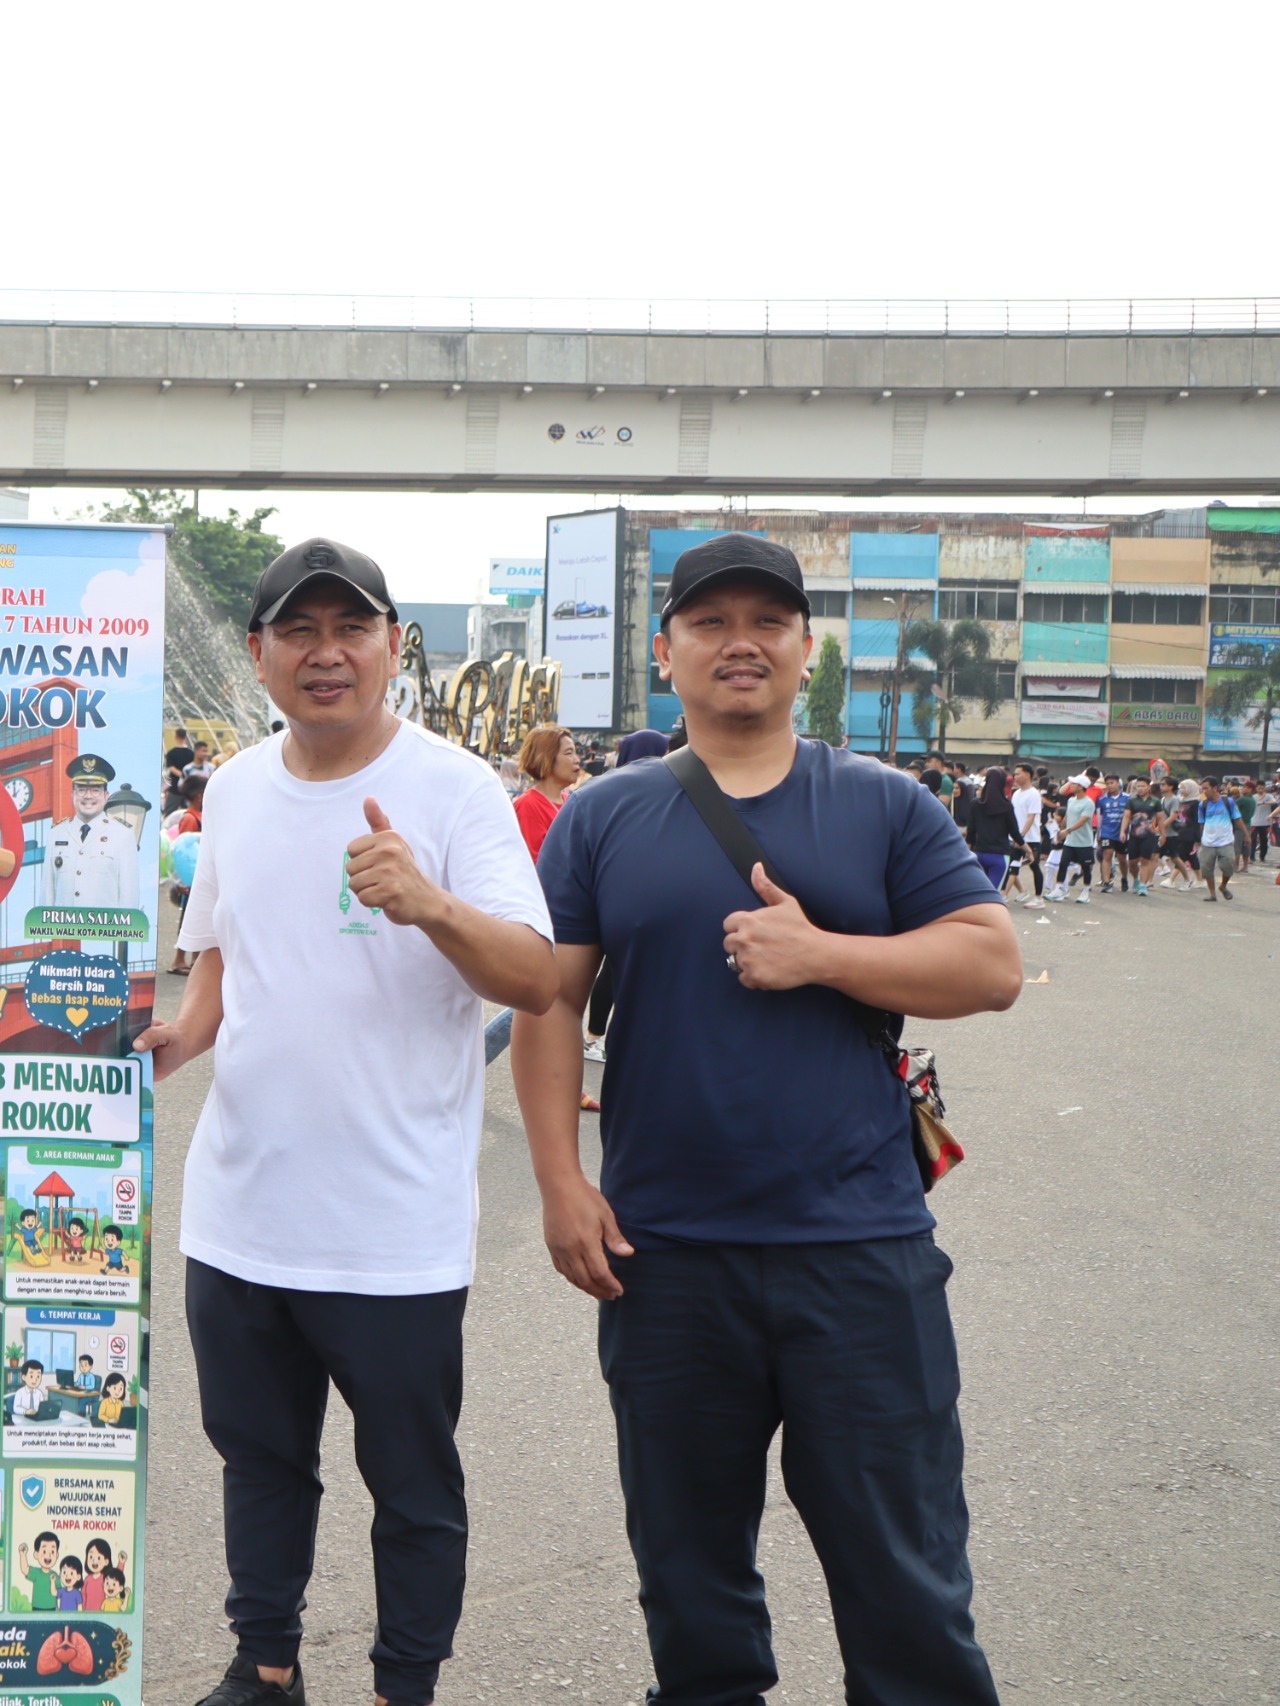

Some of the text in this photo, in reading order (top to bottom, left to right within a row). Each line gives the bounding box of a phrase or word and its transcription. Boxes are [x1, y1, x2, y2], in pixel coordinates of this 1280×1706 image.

[5, 615, 15, 633] 7
[20, 617, 93, 635] TAHUN
[99, 618, 150, 636] 2009
[1134, 711, 1197, 720] ABAS BARU
[42, 911, 131, 926] PRIMA SALAM
[29, 928, 144, 939] WAKIL WALI KOTA PALEMBANG
[39, 965, 115, 979] Nikmati Udara
[50, 979, 104, 992] Bersih Dan
[31, 993, 122, 1007] Bebas Asap Rokok
[14, 1061, 132, 1095] MENJADI
[2, 1102, 92, 1132] ROKOK
[35, 1150, 115, 1162] 3. AREA BERMAIN ANAK
[40, 1311, 101, 1320] 6. TEMPAT KERJA
[54, 1478, 114, 1489] BERSAMA KITA
[59, 1492, 106, 1502] WUJUDKAN
[47, 1506, 122, 1516] INDONESIA SEHAT
[51, 1520, 116, 1530] TANPA ROKOK!
